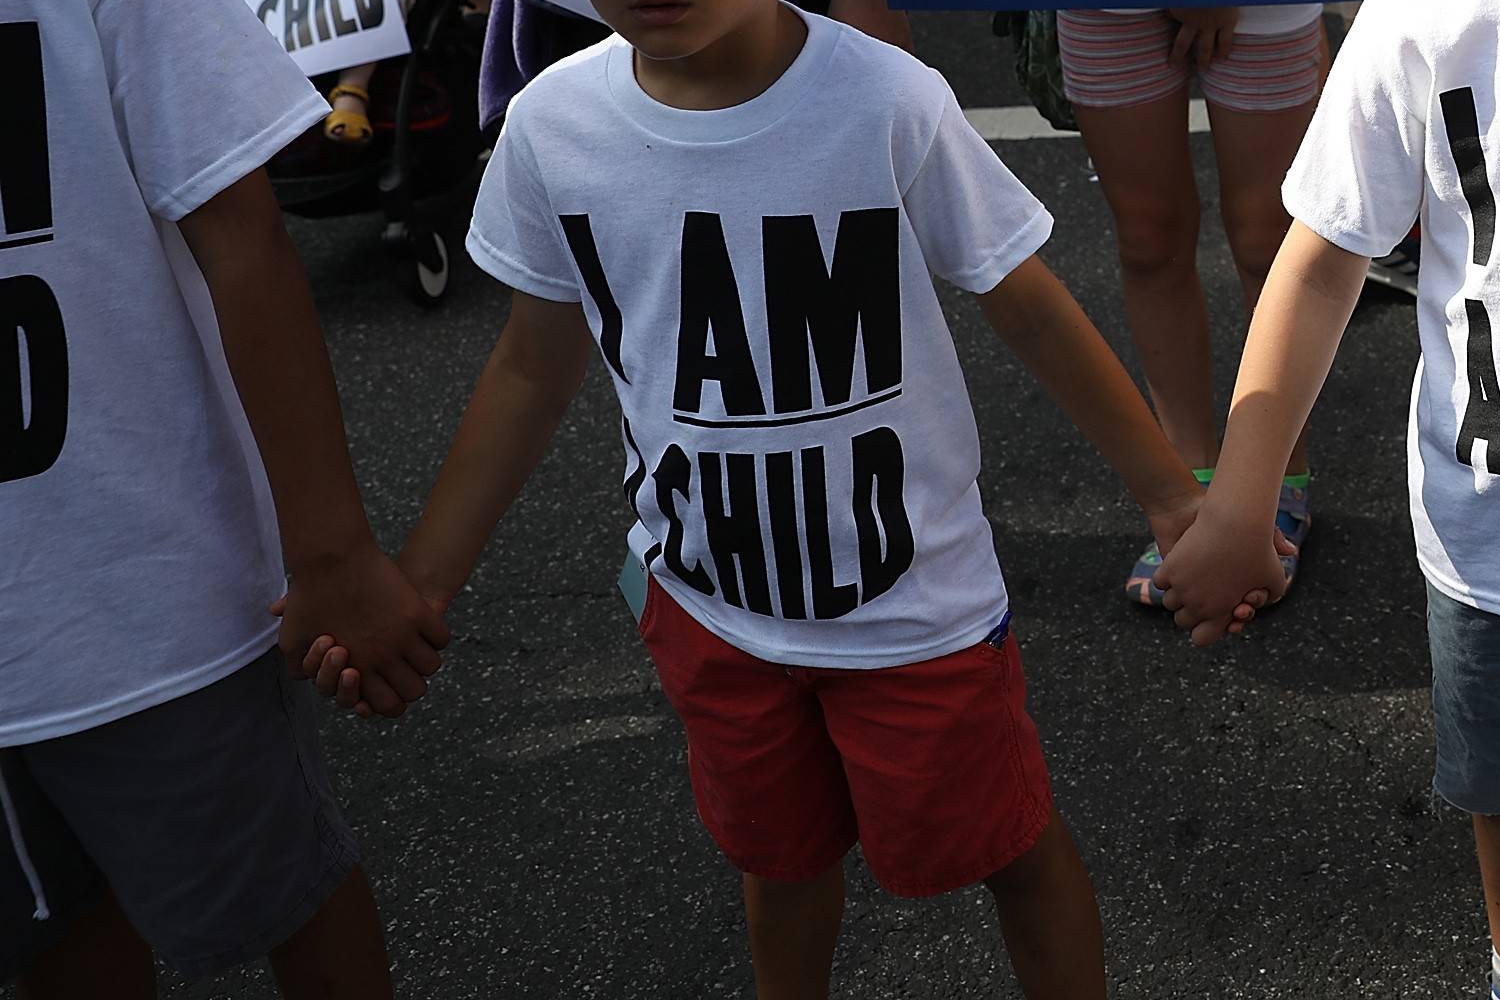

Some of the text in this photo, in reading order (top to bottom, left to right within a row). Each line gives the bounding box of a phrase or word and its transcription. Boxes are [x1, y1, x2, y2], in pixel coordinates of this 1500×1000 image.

[1438, 86, 1497, 267] I
[557, 206, 903, 417] I AM
[651, 425, 916, 621] CHILD
